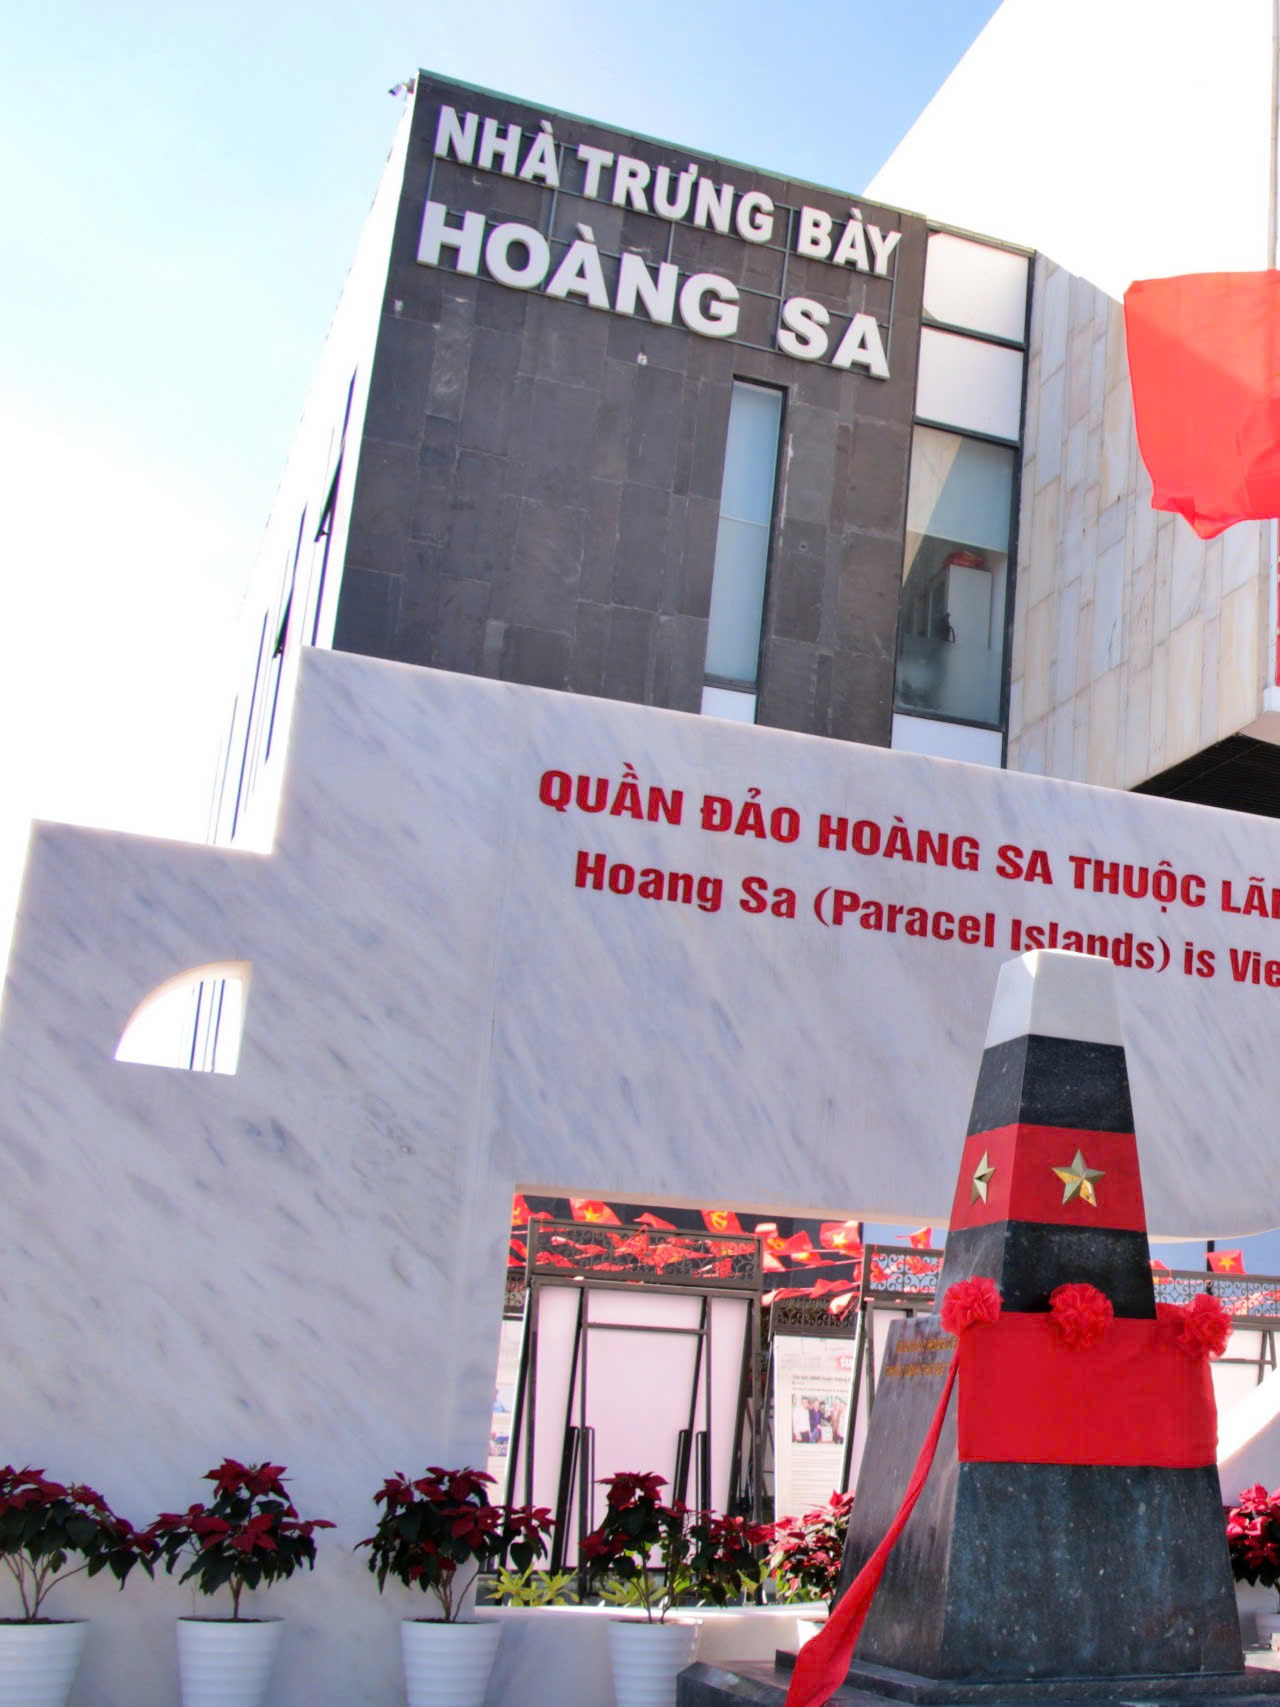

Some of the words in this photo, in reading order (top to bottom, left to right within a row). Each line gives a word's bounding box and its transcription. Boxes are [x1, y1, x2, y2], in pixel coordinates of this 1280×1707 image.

[434, 104, 561, 188] NHÀ
[577, 144, 775, 244] TRƯNG
[796, 205, 902, 277] BÀY
[416, 201, 740, 338] HOÀNG
[777, 297, 890, 380] SA
[540, 763, 684, 825] QUẦN
[700, 787, 800, 843] ĐẢO
[818, 816, 980, 872] HOÀNG
[996, 844, 1053, 885] SA
[1069, 855, 1206, 913] THUỘC
[575, 850, 724, 912] Hoang
[740, 876, 796, 919] Sa
[814, 886, 995, 948] (Paracel
[1010, 918, 1171, 973] Islands)
[1184, 942, 1215, 978] is
